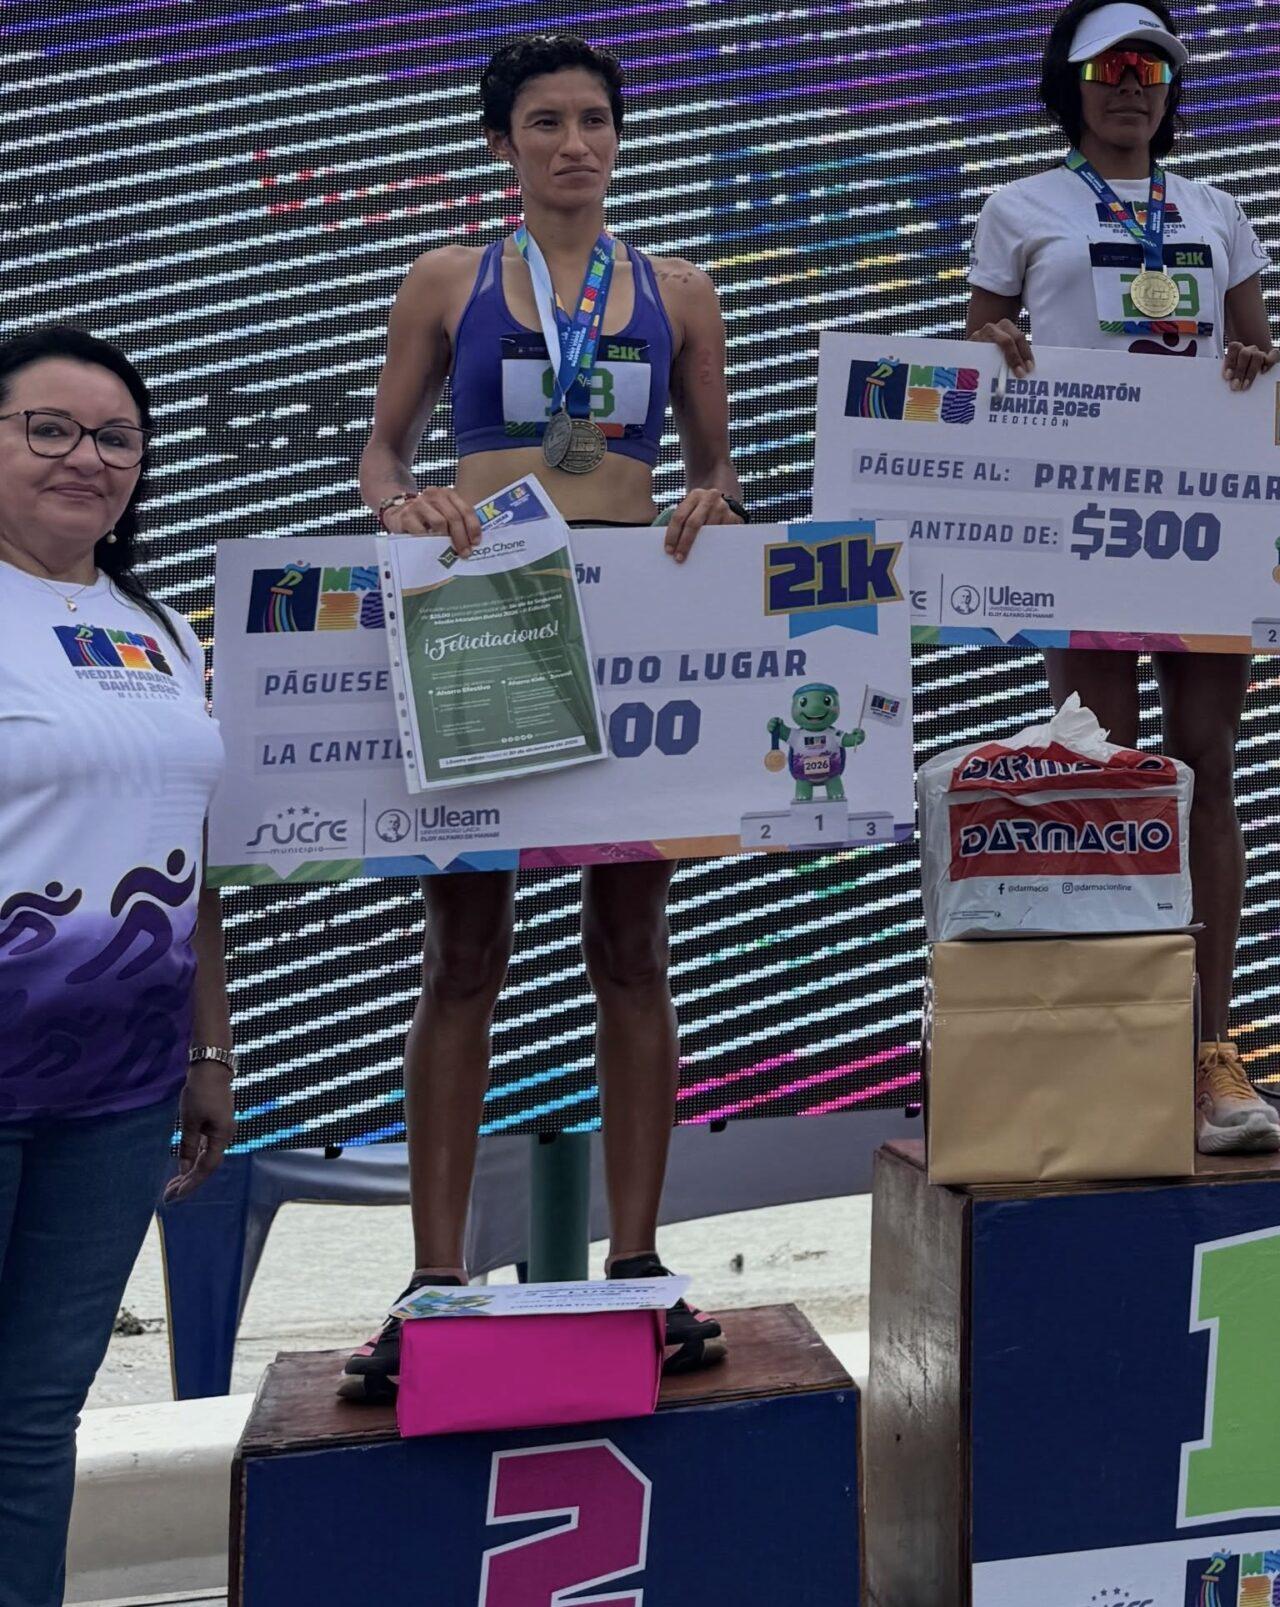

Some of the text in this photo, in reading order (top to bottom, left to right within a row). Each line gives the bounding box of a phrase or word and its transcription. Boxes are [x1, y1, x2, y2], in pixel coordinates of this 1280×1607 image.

[1175, 251, 1204, 265] 21K
[607, 344, 641, 360] 21K
[1053, 382, 1141, 402] MARATÓN
[989, 395, 1101, 418] BAHÍA 2026
[1001, 414, 1069, 427] EDICIÓN
[858, 453, 965, 479] PÁGUESE
[973, 462, 1010, 482] AL:
[1034, 463, 1164, 495] PRIMER
[909, 519, 1059, 546] ANTIDAD DE:
[1070, 502, 1222, 562] $300
[471, 546, 491, 556] oop
[988, 585, 1055, 607] Uleam
[424, 619, 560, 661] ¡Felicitaciones!
[1267, 629, 1277, 643] 2
[74, 669, 125, 680] MEDIA
[264, 669, 390, 696] PÁGUESE
[678, 649, 808, 682] LUGAR
[609, 699, 702, 758] 00
[262, 738, 404, 766] LA CANTI
[804, 759, 830, 771] 2026
[420, 805, 500, 829] Uleam
[814, 814, 824, 832] 1
[759, 823, 772, 840] 2
[865, 821, 877, 837] 3
[959, 818, 1173, 857] DARMACIO
[1007, 883, 1132, 894] @darmacio @darmacionline
[478, 1438, 653, 1607] 2
